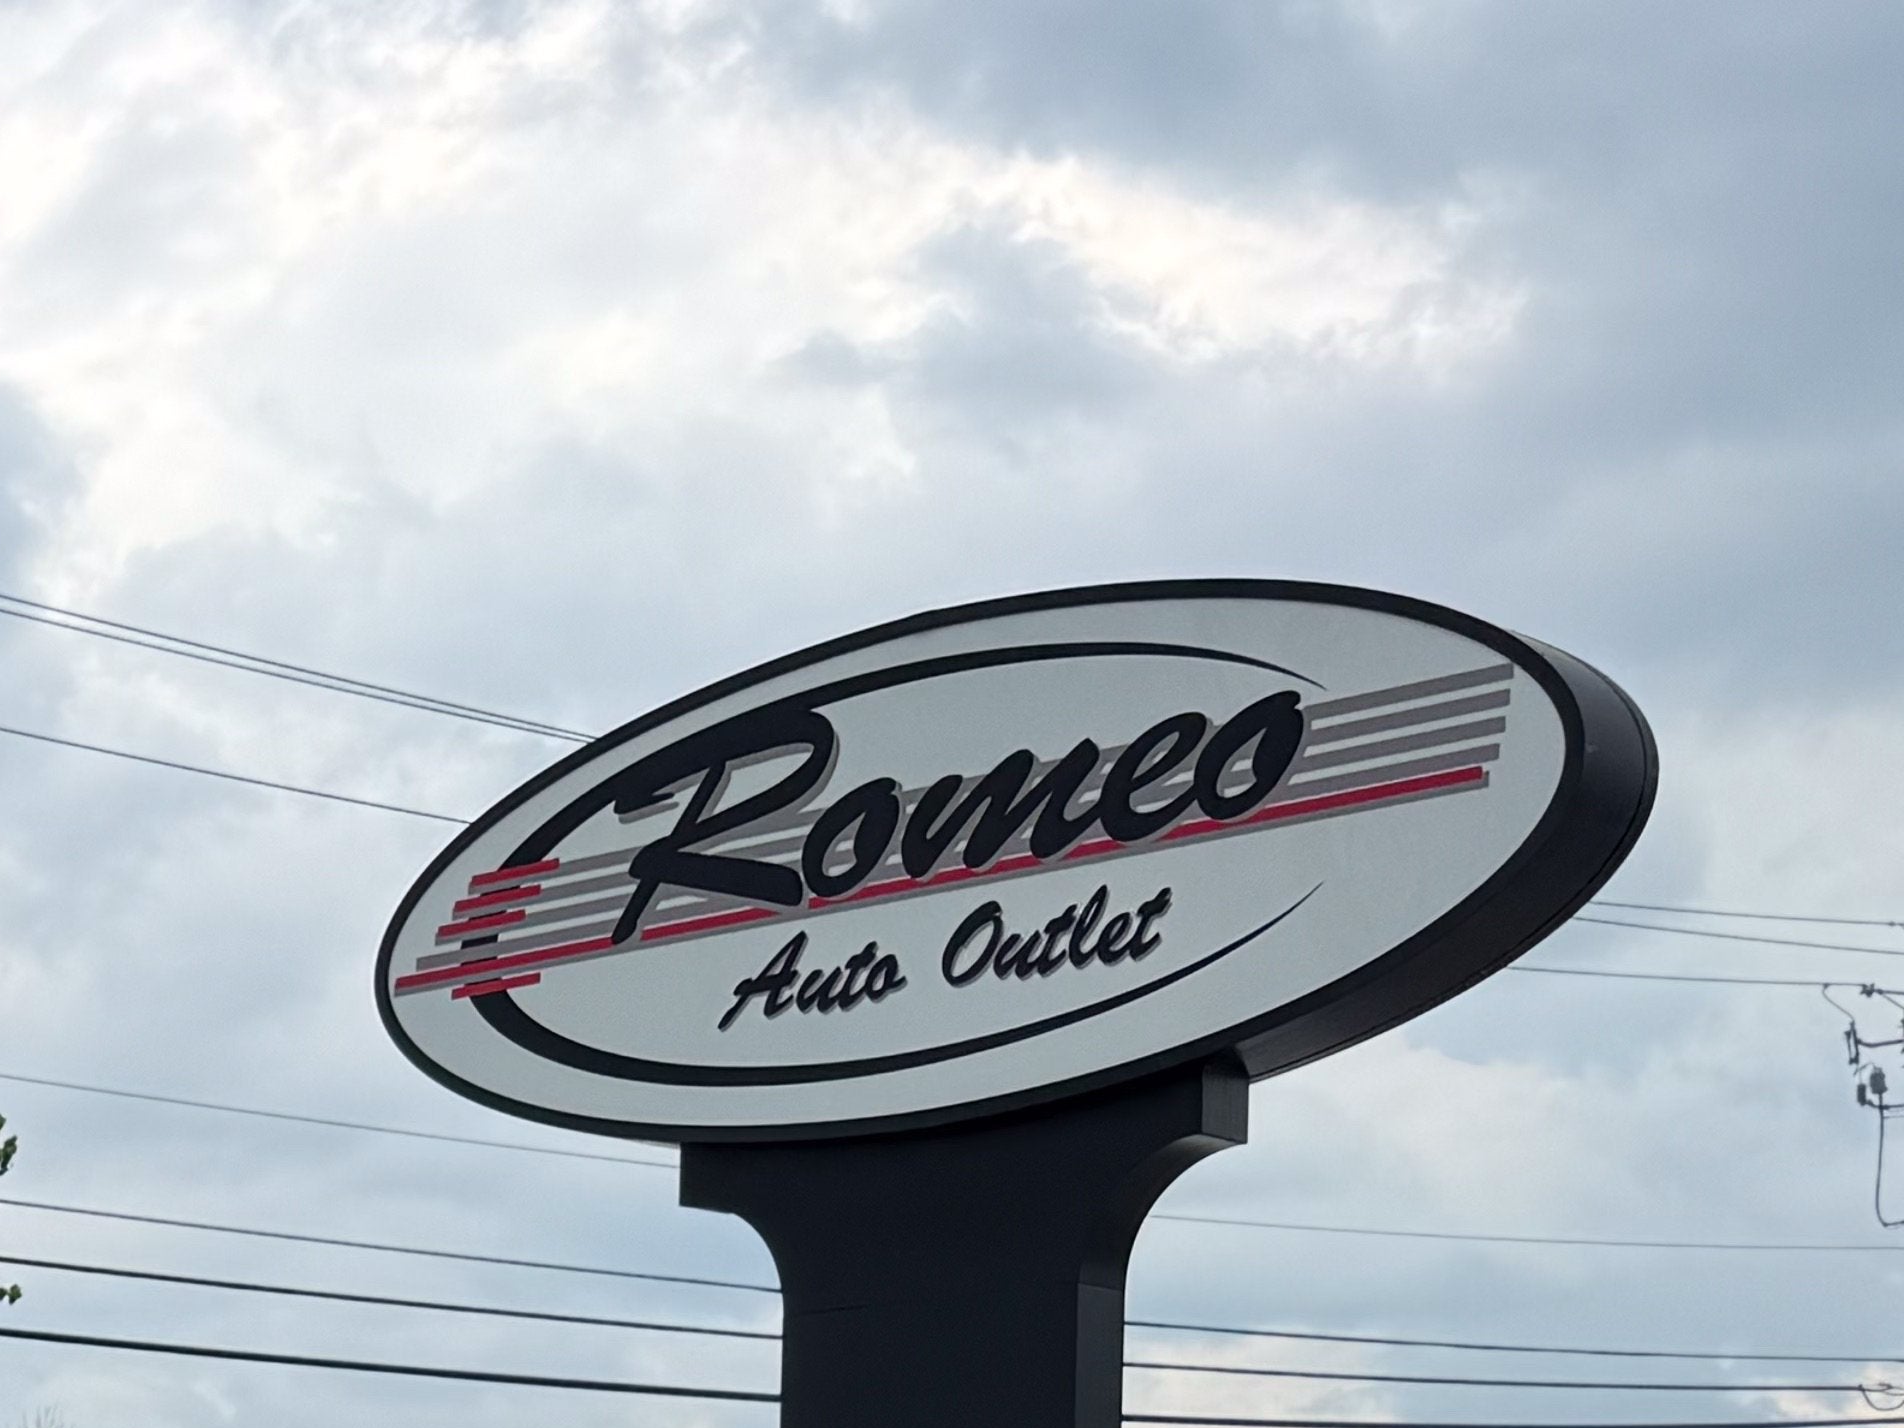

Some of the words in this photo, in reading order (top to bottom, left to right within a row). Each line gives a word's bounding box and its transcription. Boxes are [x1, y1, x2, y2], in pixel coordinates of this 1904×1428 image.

[607, 690, 1306, 943] Romeo
[717, 931, 906, 1030] Auto
[941, 885, 1172, 986] Outlet
